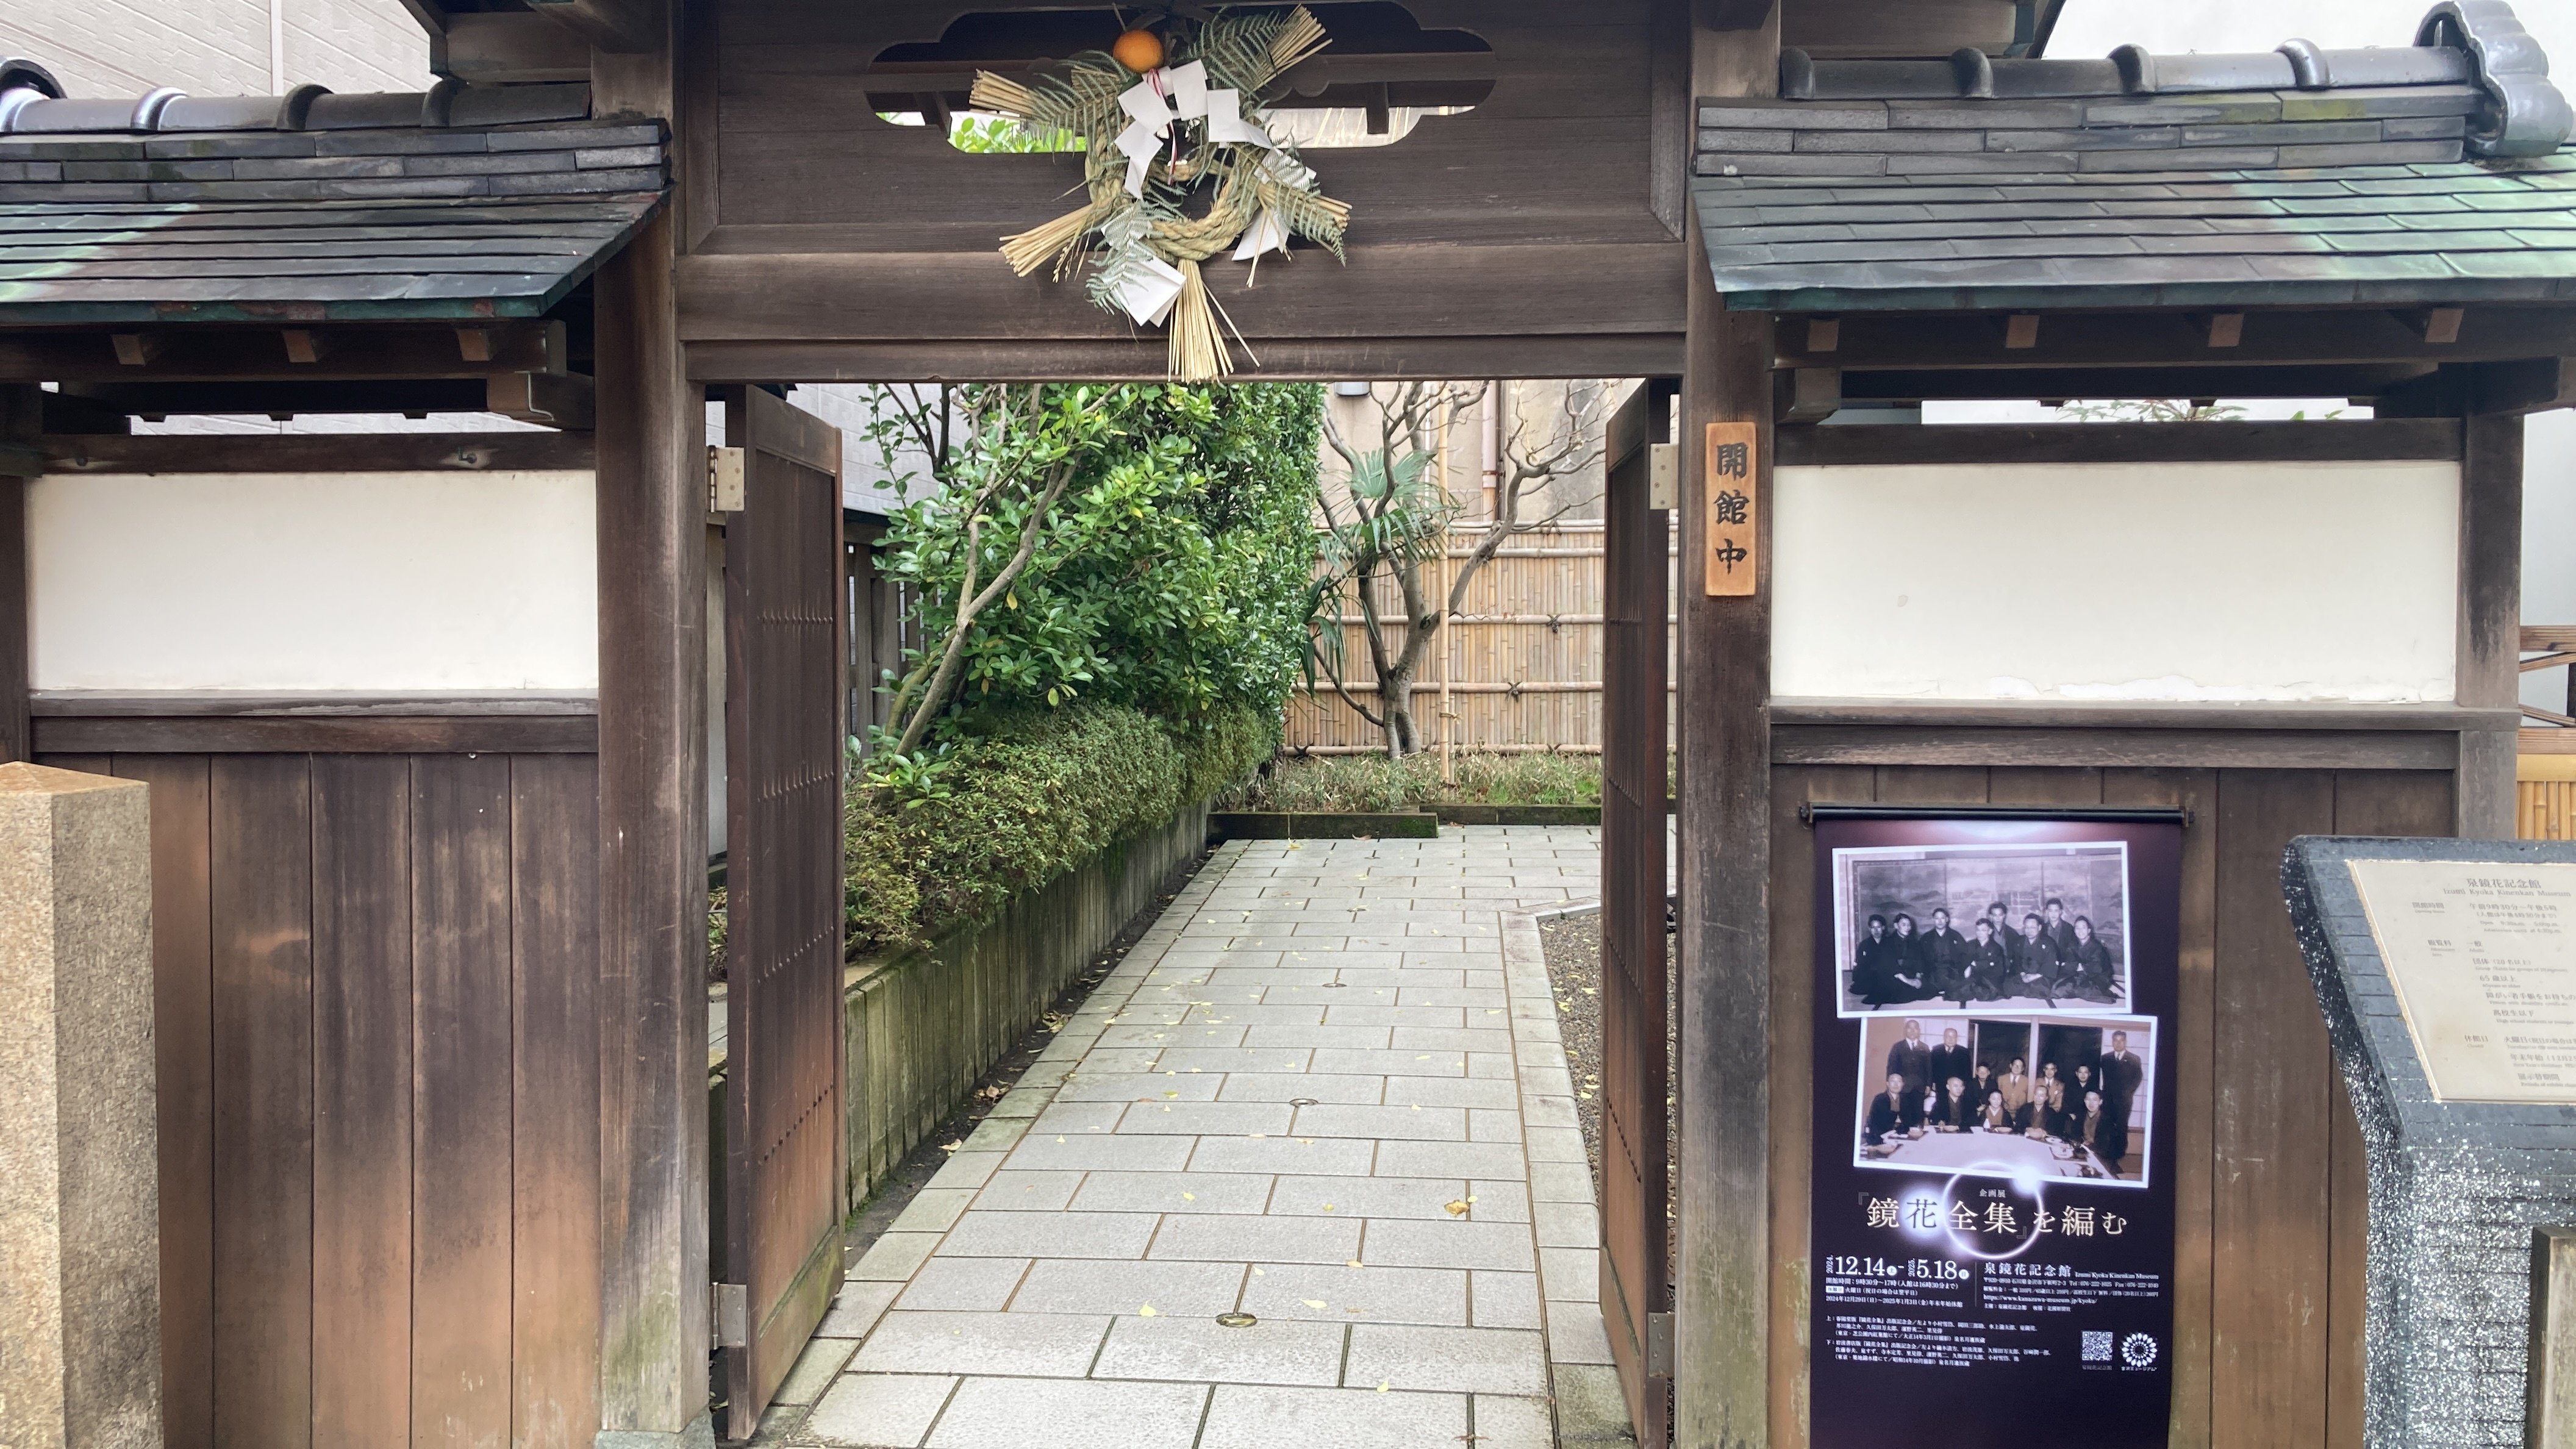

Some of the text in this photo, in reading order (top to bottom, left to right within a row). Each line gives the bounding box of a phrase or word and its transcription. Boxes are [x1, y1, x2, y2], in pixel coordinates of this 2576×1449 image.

[1713, 442, 1750, 574] 開館中
[2466, 878, 2542, 889] 泉鏡花記念館
[1980, 1189, 2006, 1198] 企画展
[1984, 1262, 2072, 1278] 泉鏡花記念館
